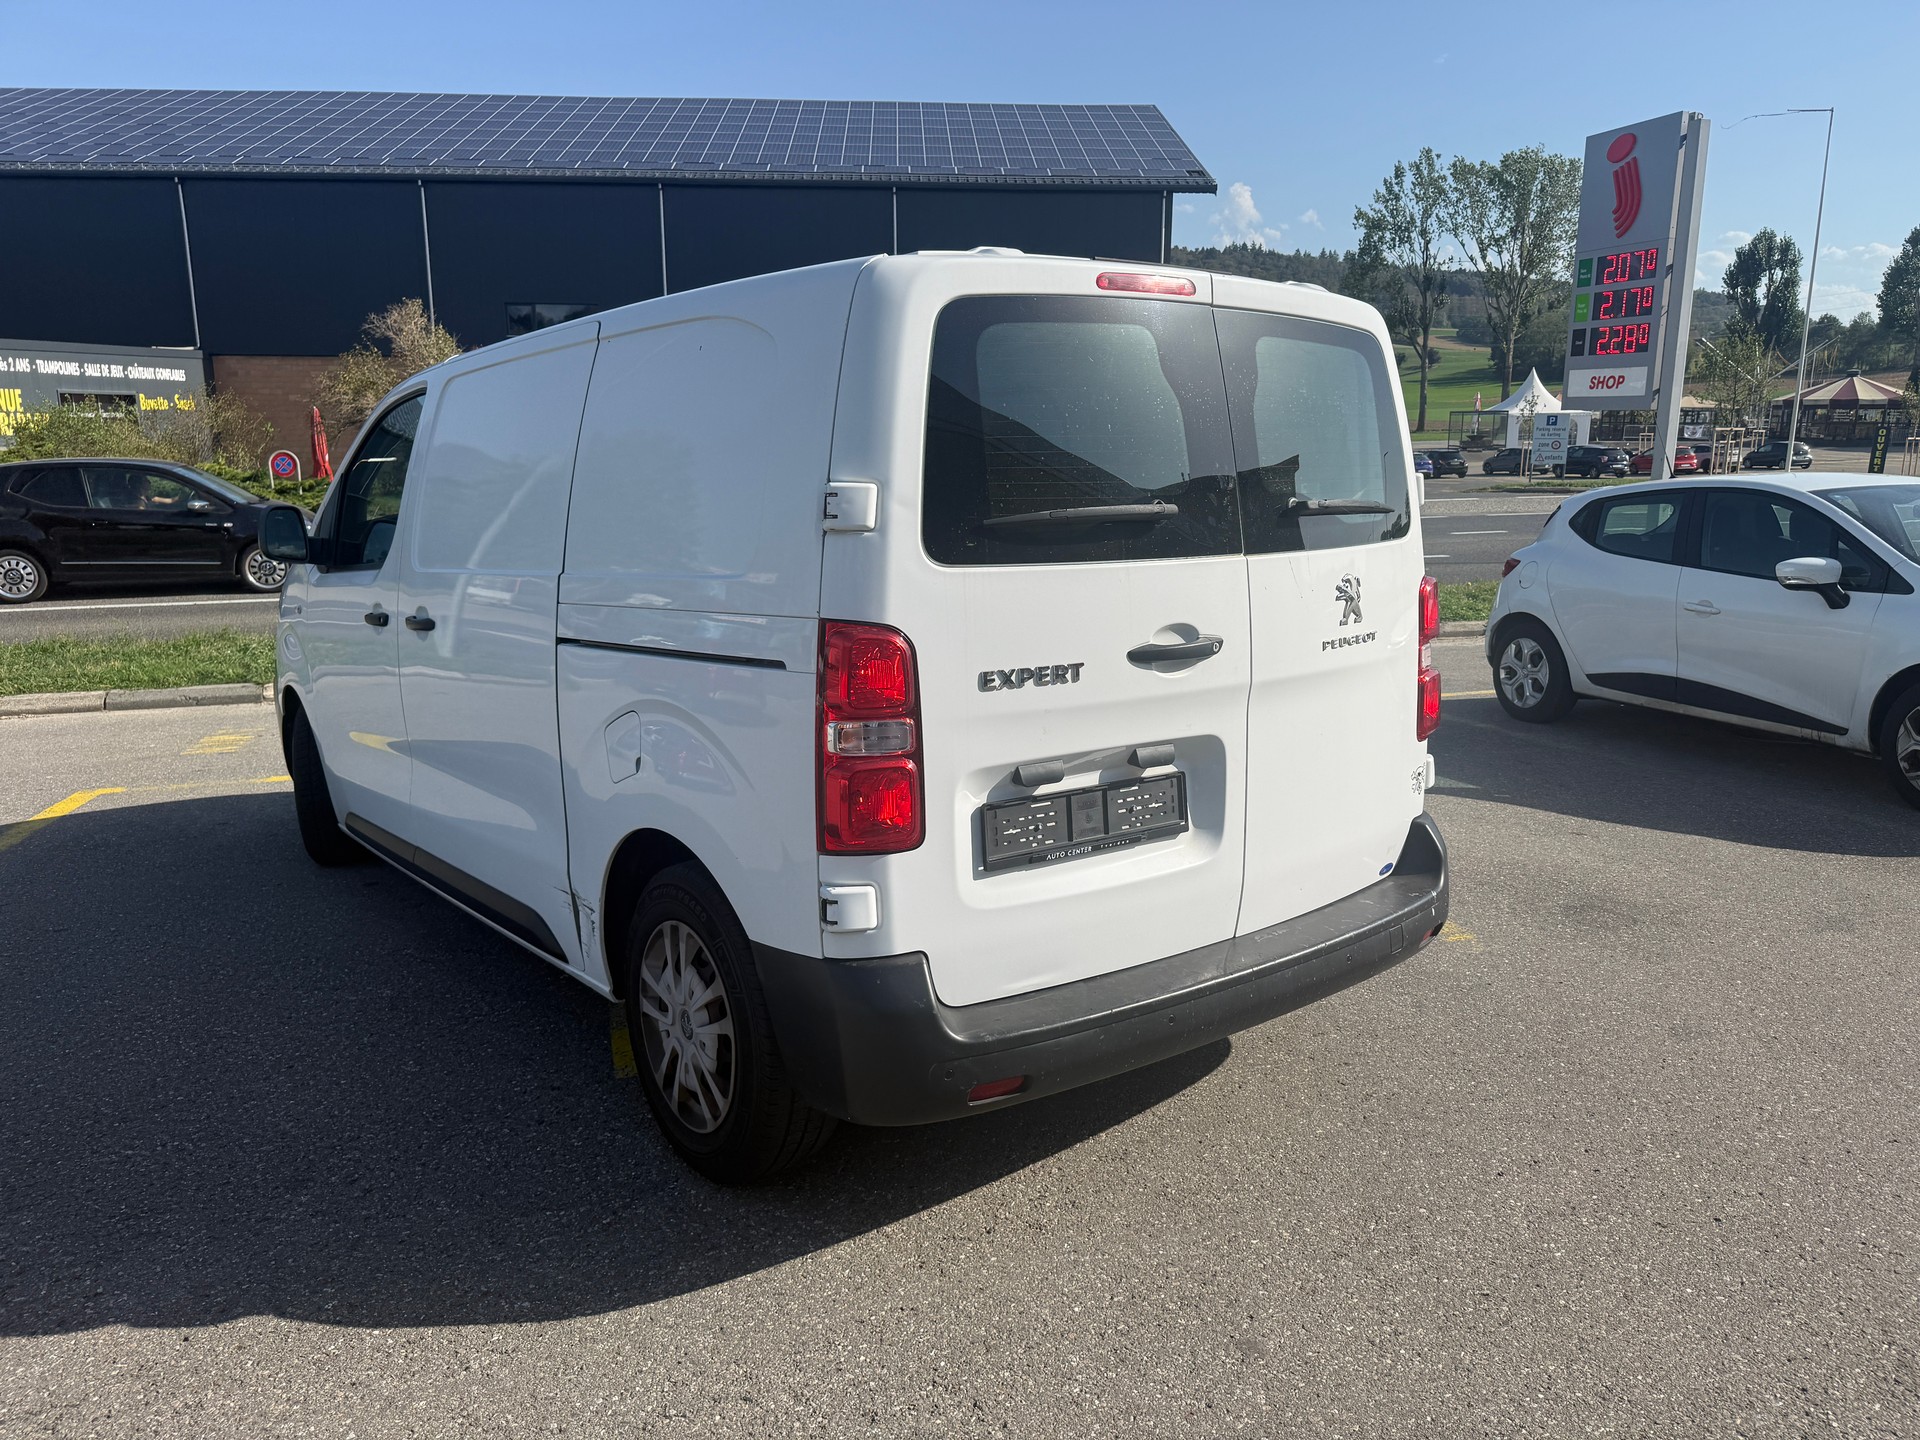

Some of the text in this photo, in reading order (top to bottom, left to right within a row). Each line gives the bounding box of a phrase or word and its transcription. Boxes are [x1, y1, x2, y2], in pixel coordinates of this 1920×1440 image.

[8, 357, 15, 372] 2
[15, 358, 31, 373] ANS
[36, 359, 80, 376] TRAMPOLINES
[84, 362, 101, 377] SALLE
[101, 364, 110, 377] DE
[110, 364, 125, 378] JEUX
[155, 367, 186, 381] GONFLABLES
[1588, 375, 1625, 390] SHOP
[139, 393, 169, 411] Buvette
[1873, 428, 1887, 472] OUVERT
[1322, 630, 1378, 652] PEUGEOT
[978, 662, 1085, 693] EXPERT
[1046, 851, 1066, 861] AUTO
[1067, 846, 1092, 857] CENTER
